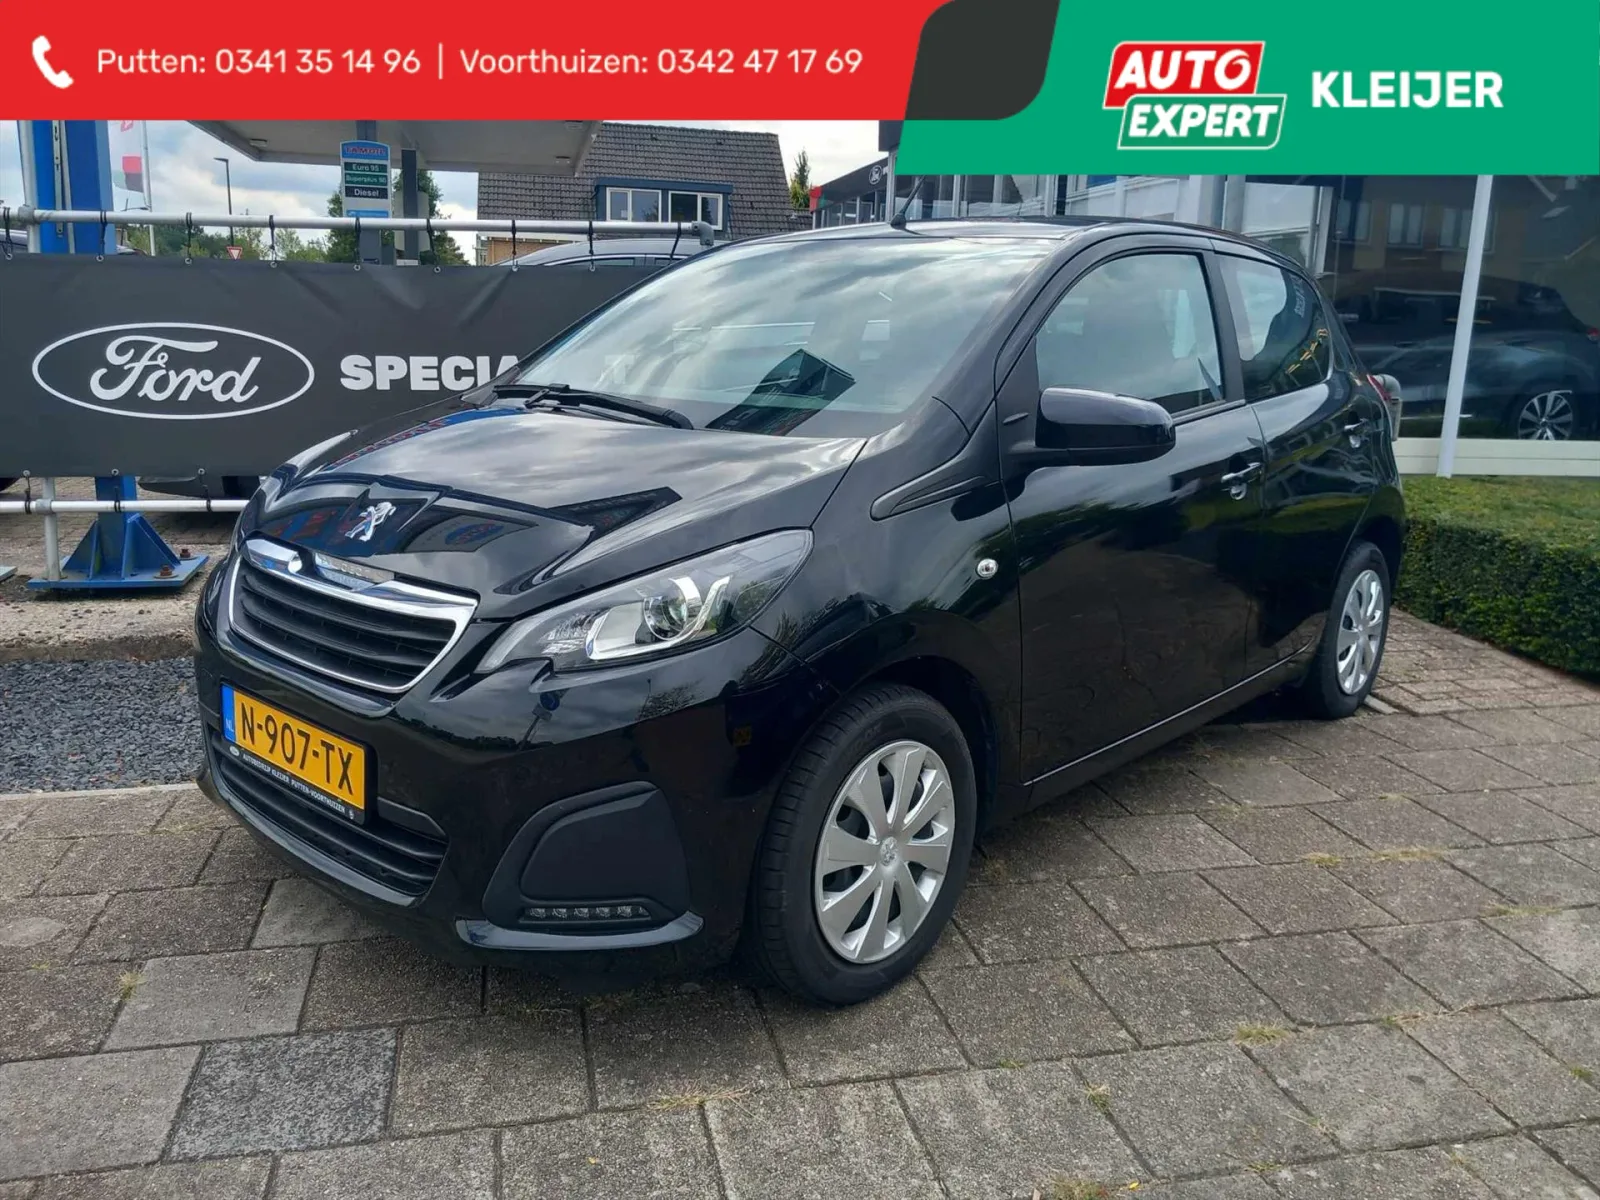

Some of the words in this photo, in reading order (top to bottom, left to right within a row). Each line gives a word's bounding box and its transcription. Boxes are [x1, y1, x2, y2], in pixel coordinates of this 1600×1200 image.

[352, 163, 370, 172] Euro
[354, 188, 380, 197] Diesel
[89, 334, 263, 403] Ford
[225, 717, 235, 732] NL
[240, 701, 354, 797] N-907-TX
